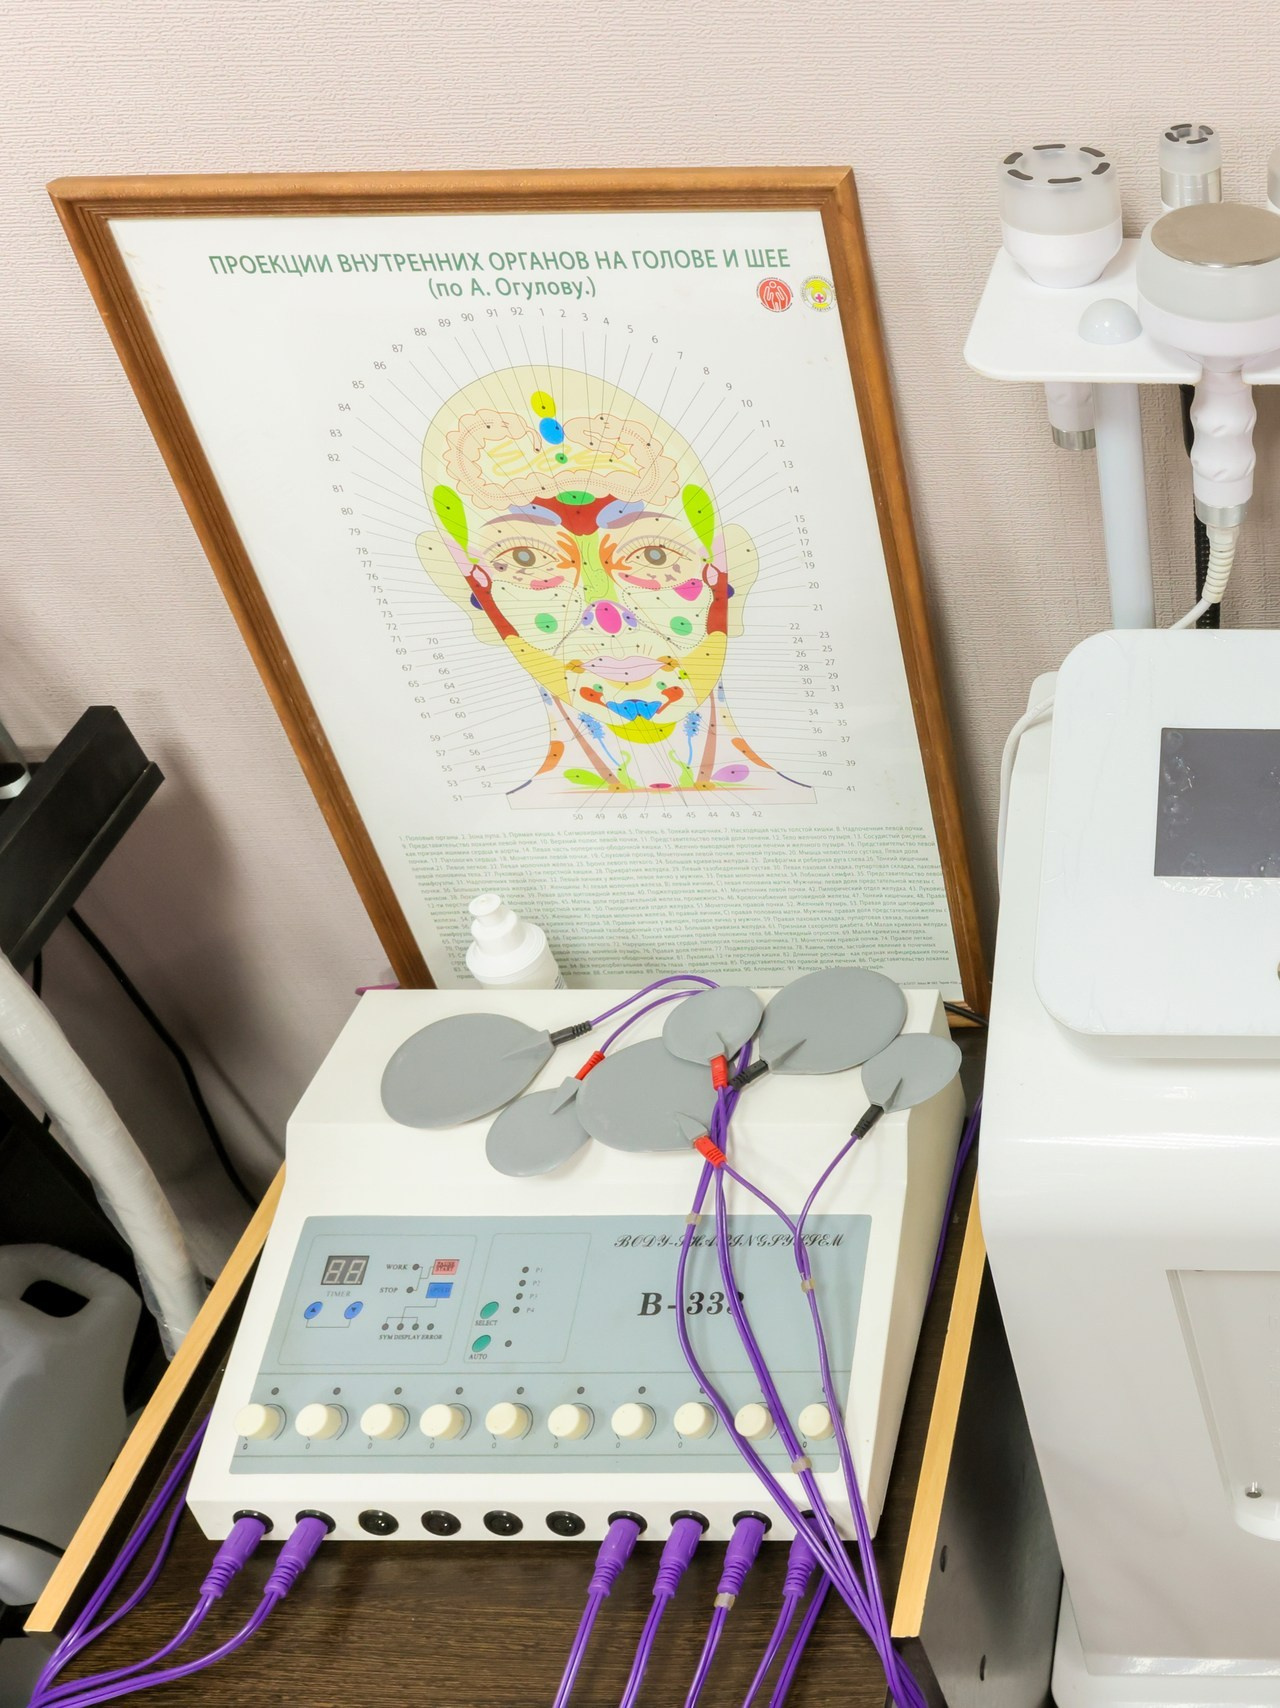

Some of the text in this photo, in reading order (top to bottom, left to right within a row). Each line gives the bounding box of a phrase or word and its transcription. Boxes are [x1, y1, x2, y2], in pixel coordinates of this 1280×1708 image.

[208, 248, 791, 278] ПРОЕКЦИИ ВНУТРЕННИХ ОРГАНОВ НА ГОЛОВЕ И ШЕЕ
[428, 276, 596, 301] (по А. Огулову.)
[485, 308, 499, 318] 91
[510, 306, 525, 316] 92
[460, 312, 475, 322] 90
[437, 318, 452, 328] 89
[413, 327, 428, 337] 88
[391, 343, 404, 353] 87
[373, 360, 387, 370] 86
[351, 379, 365, 390] 85
[337, 402, 352, 412] 84
[740, 399, 753, 408] 10
[759, 419, 771, 429] 11
[329, 428, 343, 438] 83
[773, 439, 786, 448] 12
[327, 453, 341, 462] 82
[782, 460, 794, 469] 13
[331, 484, 344, 493] 81
[788, 485, 800, 494] 14
[340, 506, 354, 516] 80
[794, 514, 806, 523] 15
[348, 527, 361, 536] 79
[796, 526, 809, 535] 16
[799, 538, 810, 547] 17
[355, 546, 369, 556] 78
[801, 550, 814, 558] 18
[360, 559, 373, 569] 77
[804, 561, 816, 570] 19
[365, 572, 379, 581] 76
[370, 585, 384, 594] 75
[807, 581, 820, 590] 20
[375, 597, 389, 606] 74
[812, 603, 824, 612] 21
[380, 610, 394, 619] 73
[385, 622, 399, 631] 72
[788, 622, 801, 631] 22
[818, 631, 830, 639] 23
[791, 636, 804, 645] 24
[822, 644, 833, 653] 25
[795, 649, 807, 658] 26
[824, 658, 836, 667] 27
[798, 663, 810, 672] 28
[827, 671, 839, 680] 29
[801, 677, 813, 685] 30
[830, 684, 841, 693] 31
[803, 690, 816, 698] 32
[833, 701, 845, 710] 33
[807, 708, 819, 716] 34
[836, 719, 848, 727] 35
[811, 726, 823, 734] 36
[840, 735, 851, 744] 37
[816, 750, 828, 758] 38
[386, 1263, 408, 1271] WORK
[325, 1290, 351, 1298] TIMER
[379, 1286, 398, 1294] STOP
[474, 1319, 498, 1327] SELECT
